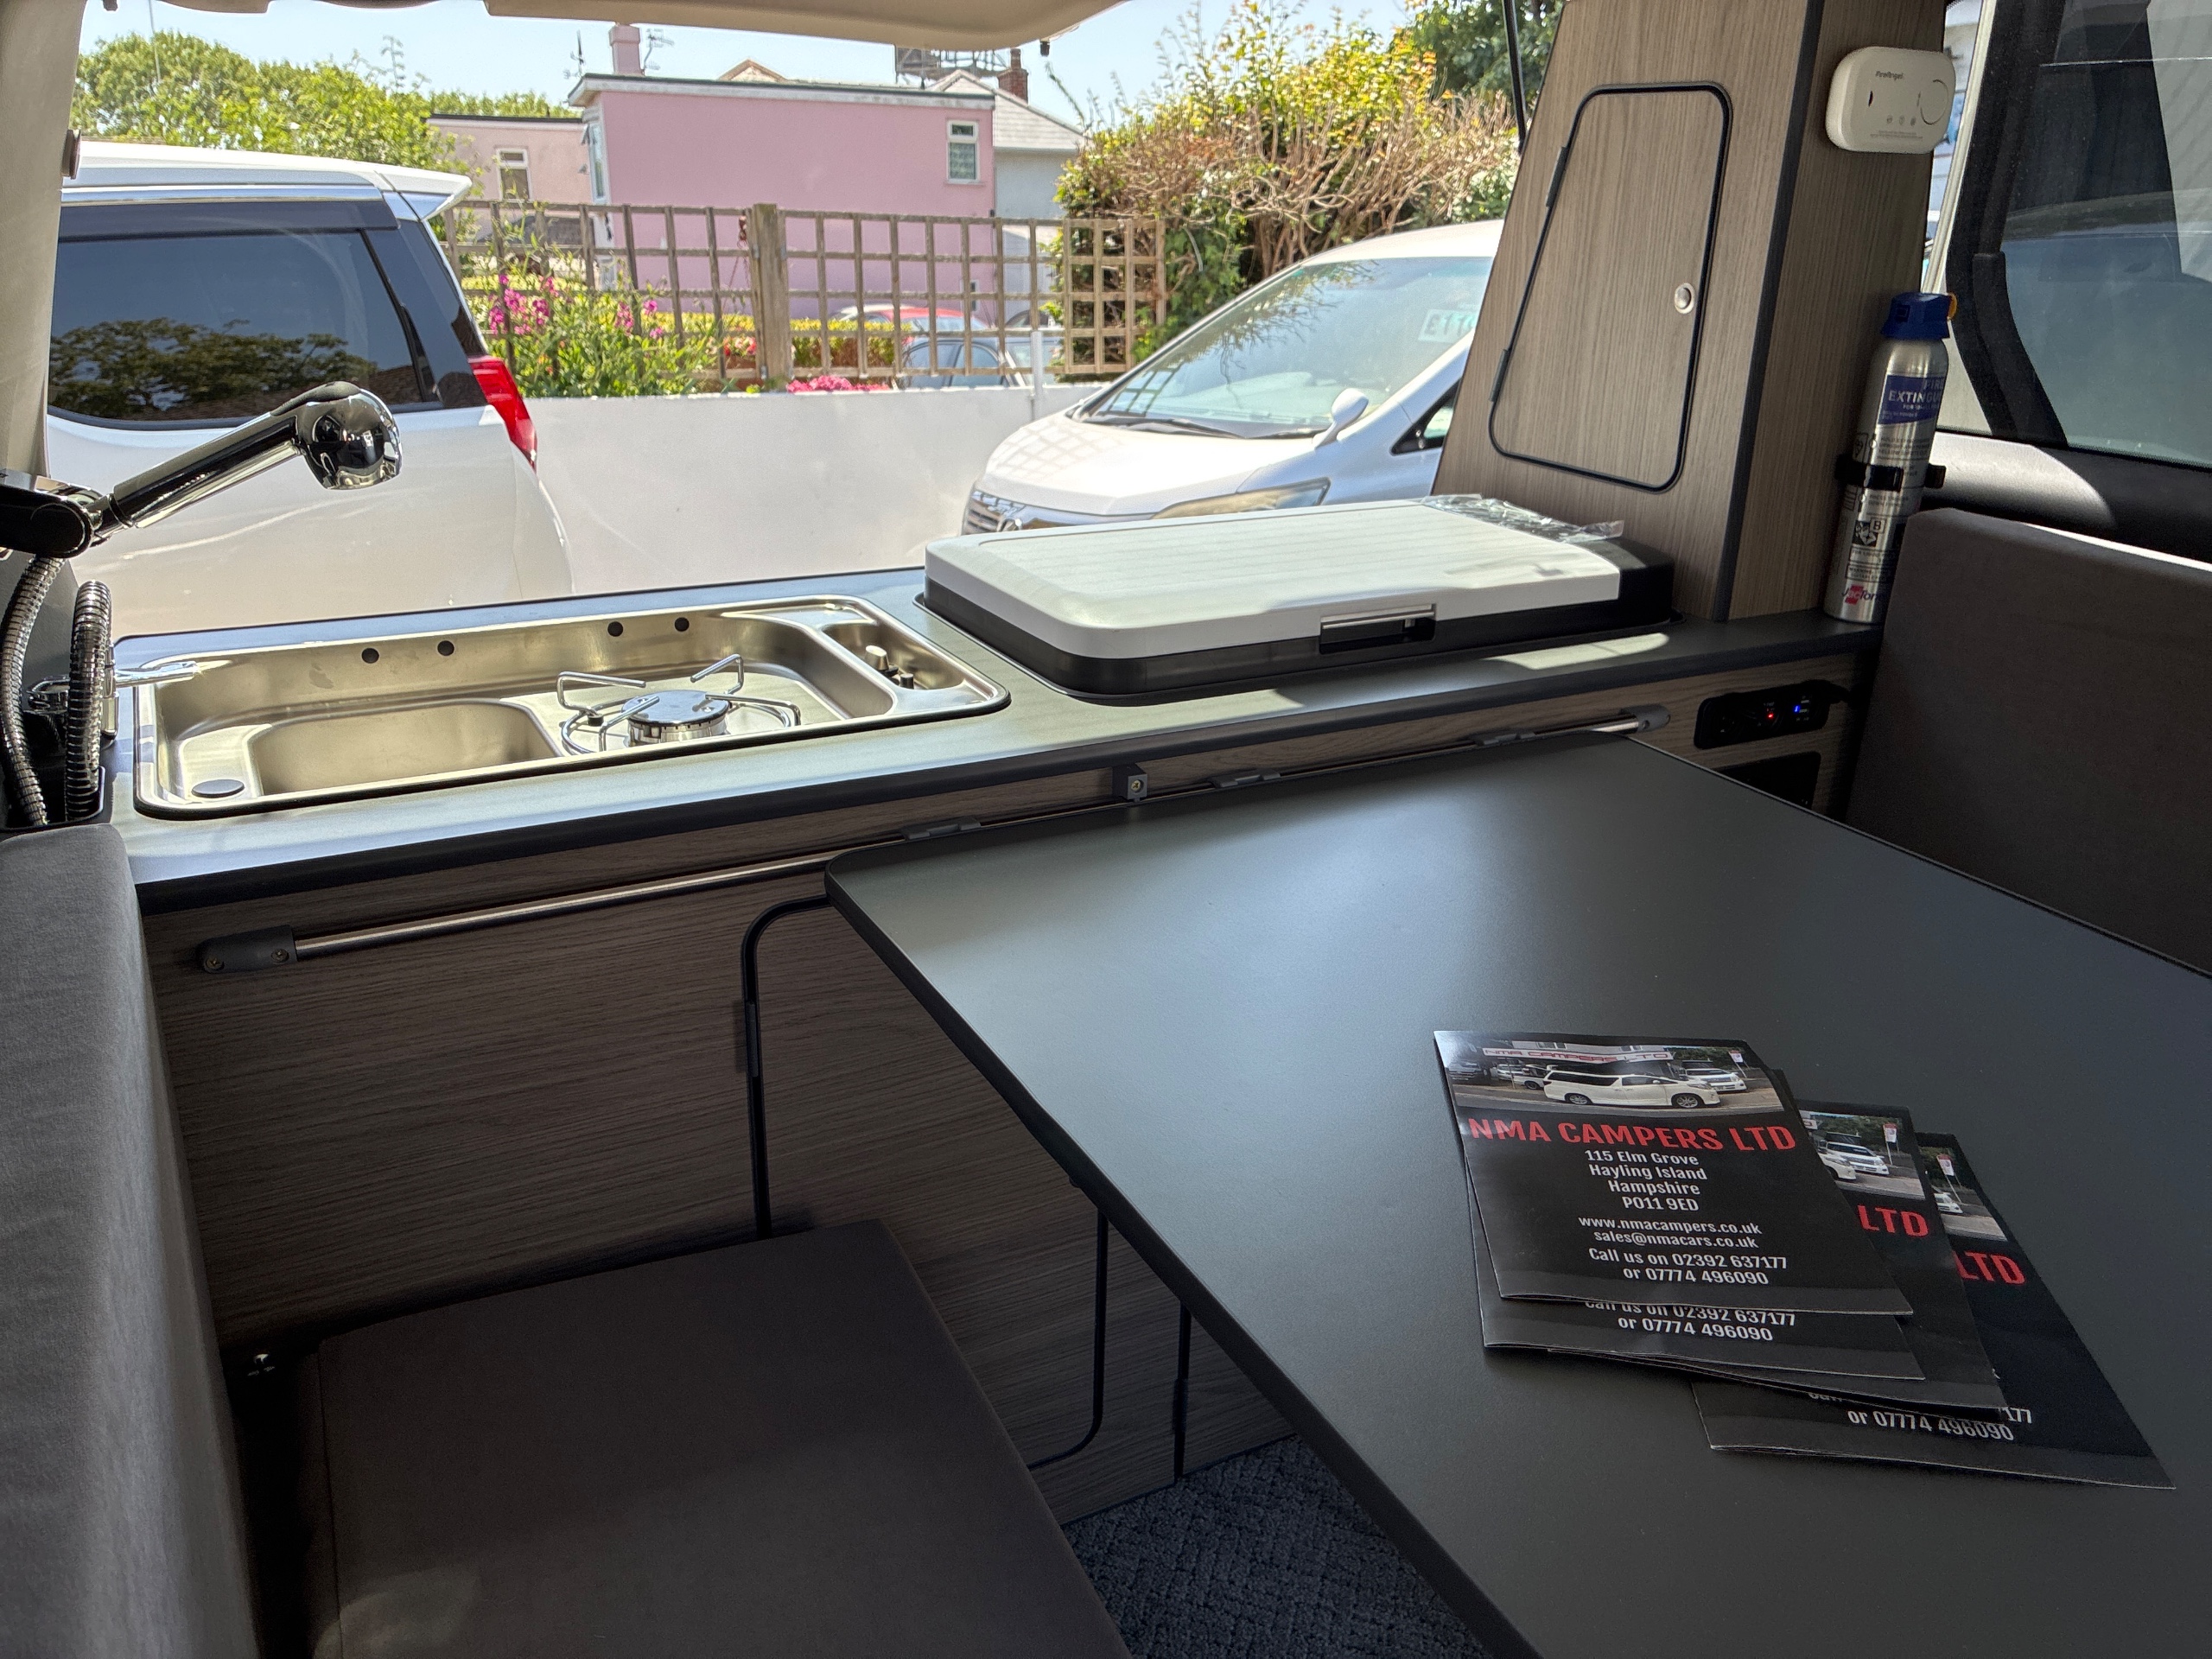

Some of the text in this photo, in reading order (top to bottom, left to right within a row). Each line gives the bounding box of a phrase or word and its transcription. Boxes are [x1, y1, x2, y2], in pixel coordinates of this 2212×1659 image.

[1528, 1052, 1618, 1062] CAMPERS
[1468, 1117, 1796, 1151] NMA CAMPERS LTD
[1585, 1149, 1700, 1166] 115 Elm Grove
[1589, 1164, 1708, 1180] Hayling Island
[1608, 1179, 1701, 1196] Hampshire
[1666, 1198, 1700, 1211] 9ED
[1578, 1217, 1763, 1235] www.nmacampers.co.uk
[1857, 1205, 1929, 1237] LTD
[1593, 1230, 1759, 1249] sales@nmacars.co.uk
[1588, 1248, 1788, 1269] Call us on 02392 637177
[1953, 1250, 2026, 1285] LTD
[1623, 1268, 1770, 1285] or 07774 496090
[1620, 1303, 1642, 1314] us
[1646, 1305, 1669, 1317] on
[1672, 1306, 1731, 1322] 02392
[1734, 1309, 1796, 1326] 637177
[1618, 1318, 1773, 1341] or 07774 496090
[1847, 1410, 2014, 1441] or 07774 496090
